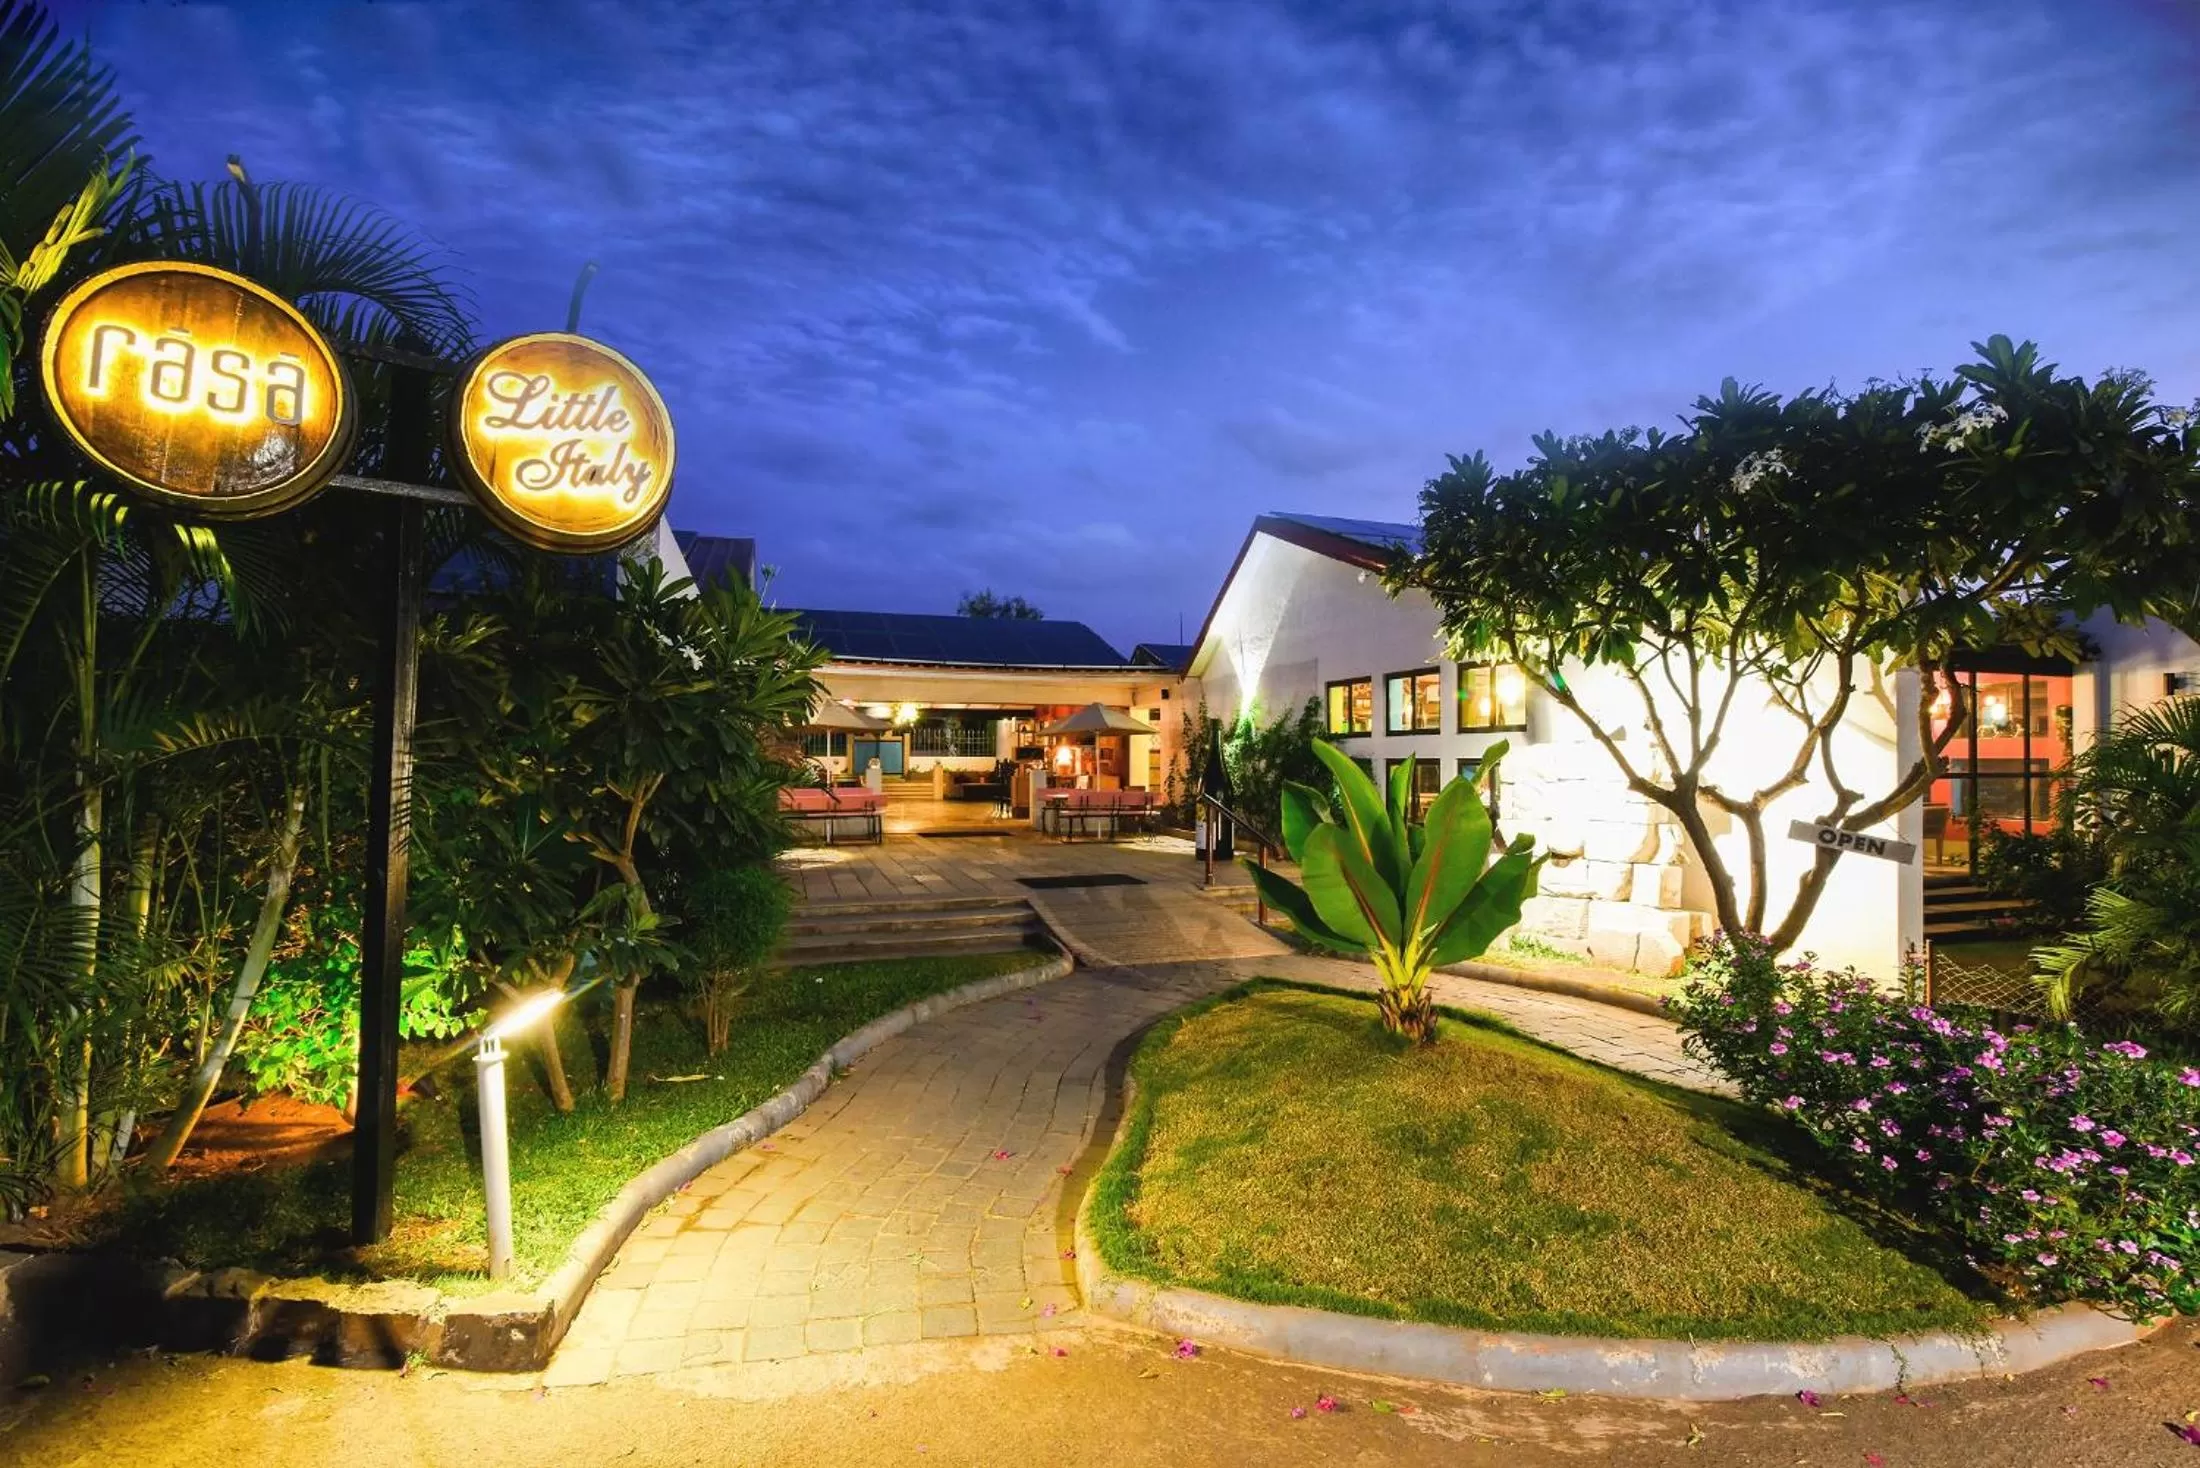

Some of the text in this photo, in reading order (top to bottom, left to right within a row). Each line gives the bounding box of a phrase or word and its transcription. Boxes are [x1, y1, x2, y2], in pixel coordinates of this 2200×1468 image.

[484, 371, 630, 433] Little
[516, 439, 651, 503] Italy
[1818, 829, 1885, 855] OPEN
